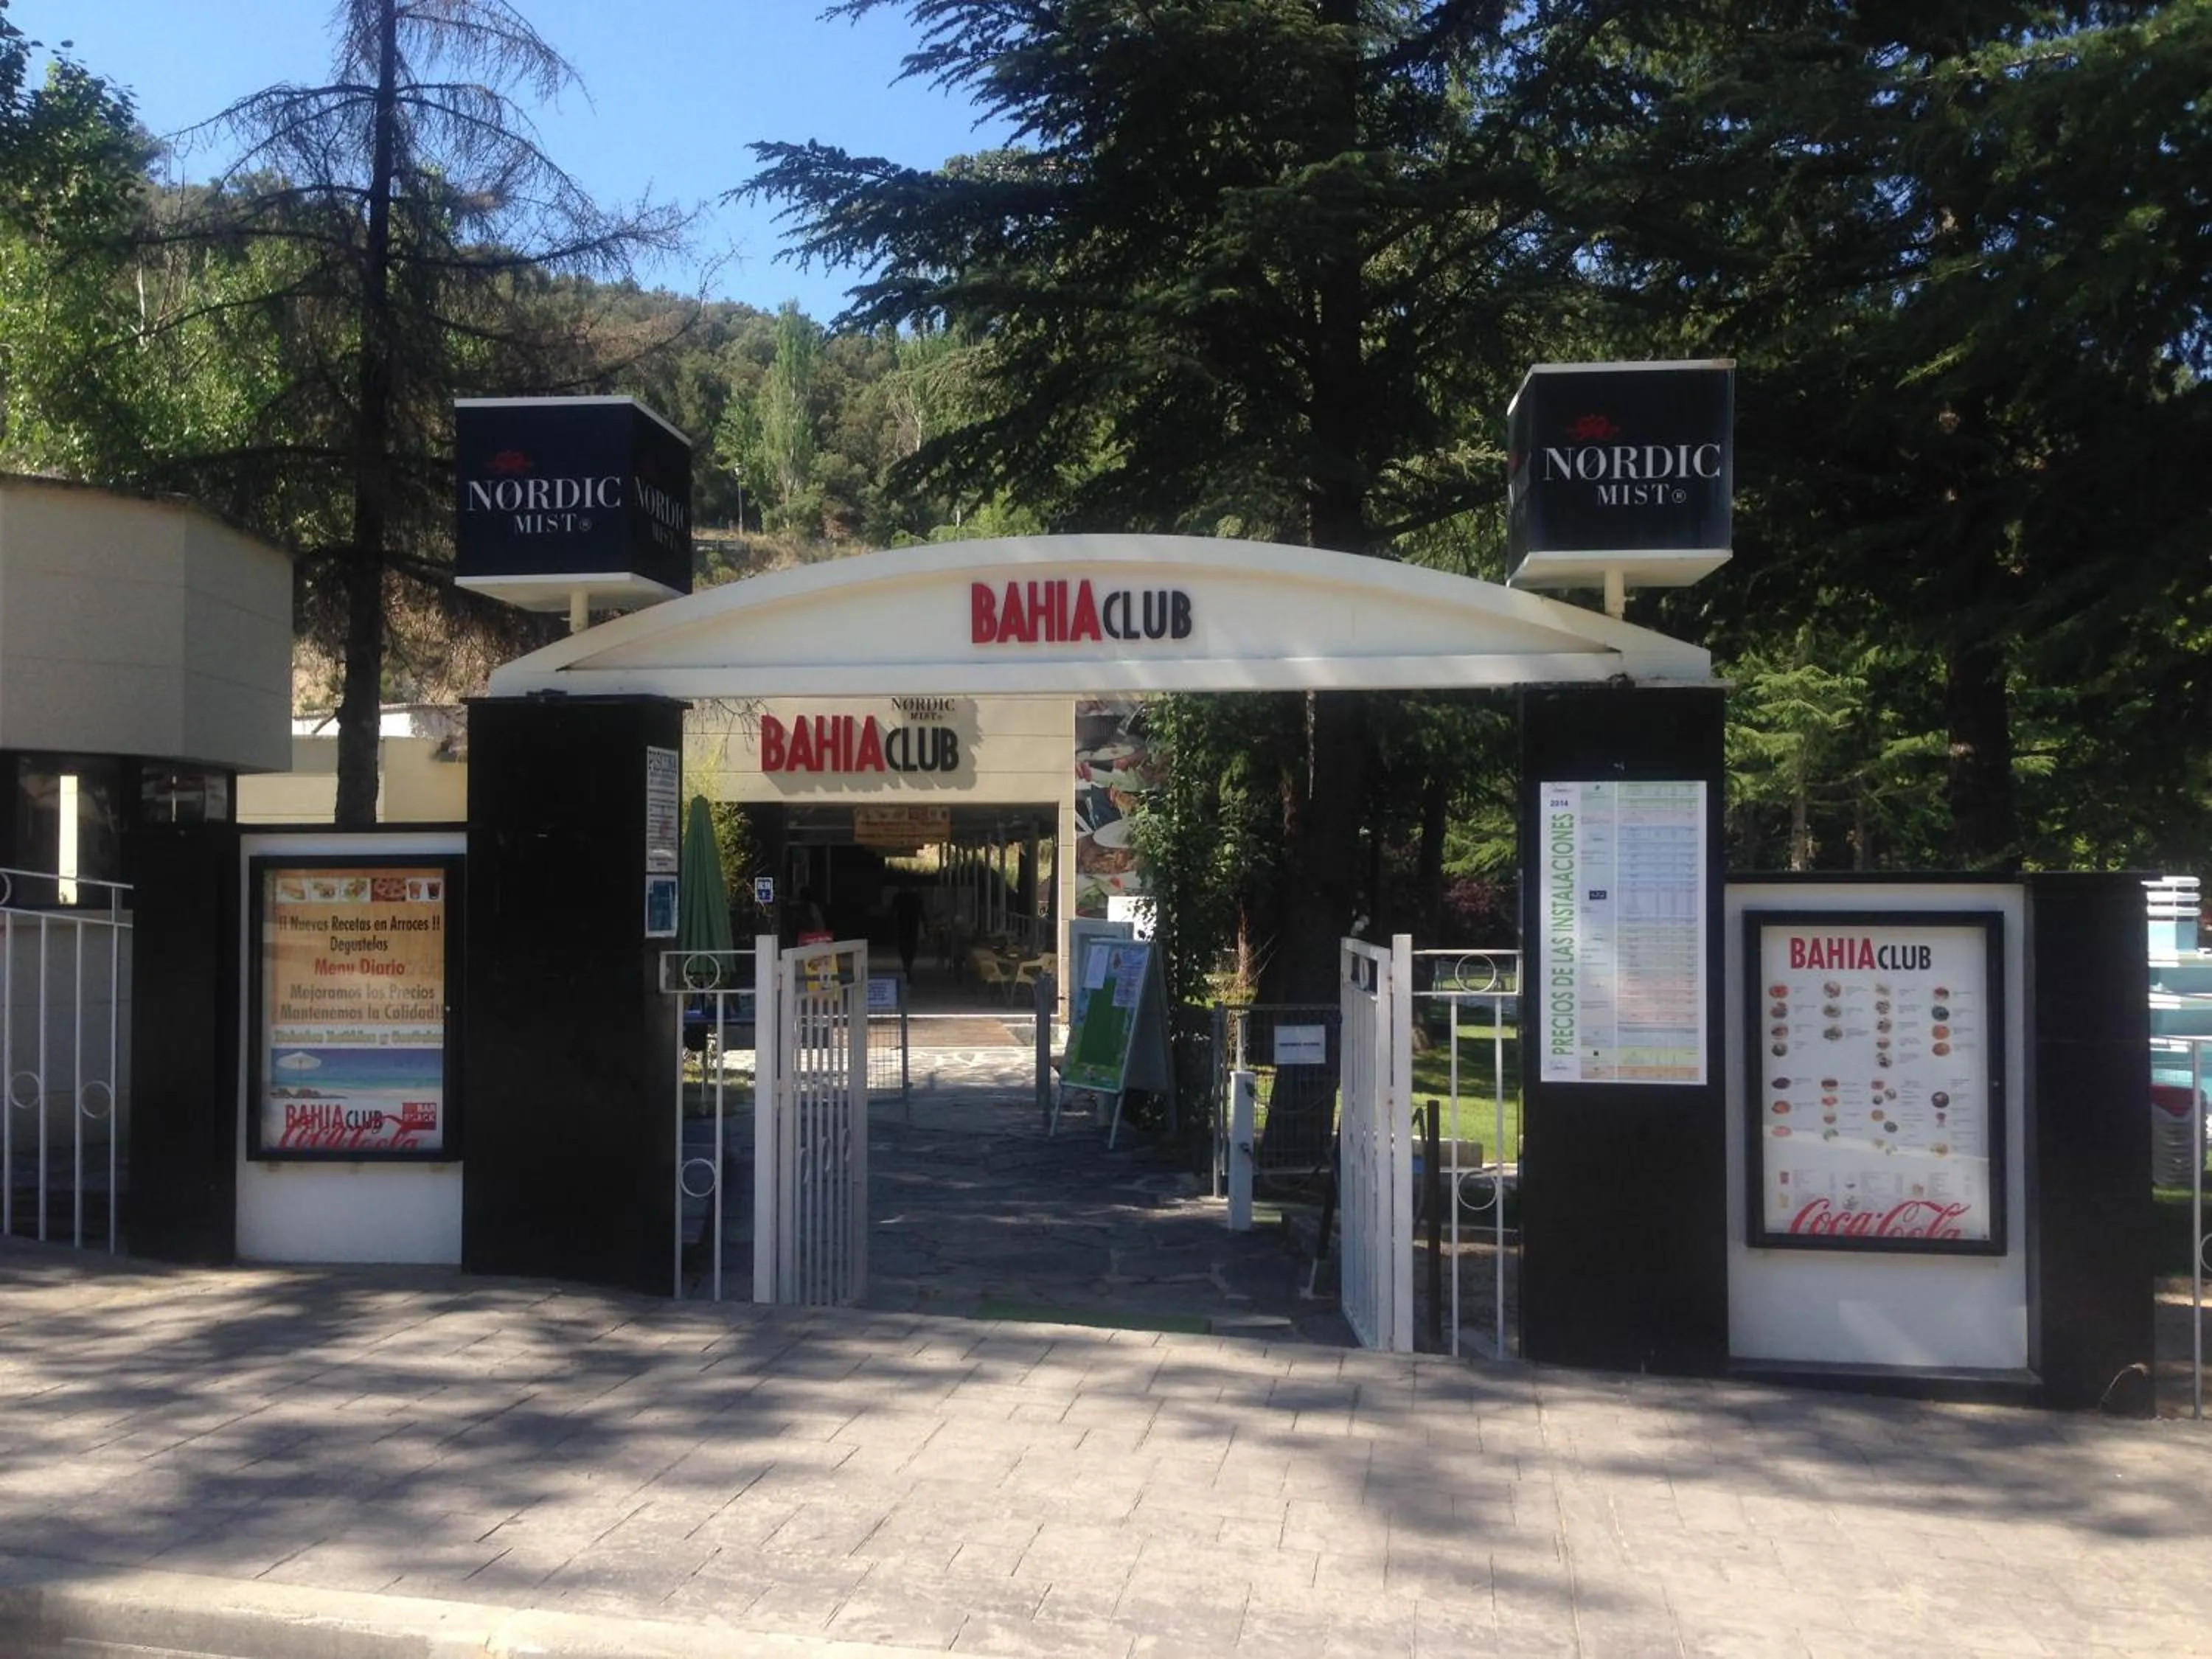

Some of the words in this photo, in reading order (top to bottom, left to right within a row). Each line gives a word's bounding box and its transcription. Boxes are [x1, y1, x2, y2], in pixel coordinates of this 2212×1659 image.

[1551, 813, 1574, 932] INSTALACIONES
[331, 916, 371, 931] Recetas
[374, 921, 387, 931] en
[390, 916, 429, 931] Arroces
[330, 935, 389, 956] Degustelas
[1551, 937, 1574, 962] LAS
[314, 959, 355, 975] Menu
[360, 959, 405, 975] Diario
[1551, 968, 1574, 987] DE
[290, 984, 361, 1004] Mejoramos
[366, 984, 386, 1001] los
[389, 984, 435, 1000] Precios
[280, 1004, 363, 1020] Mantenemos
[369, 1004, 380, 1020] la
[1551, 992, 1574, 1055] PRECIOS
